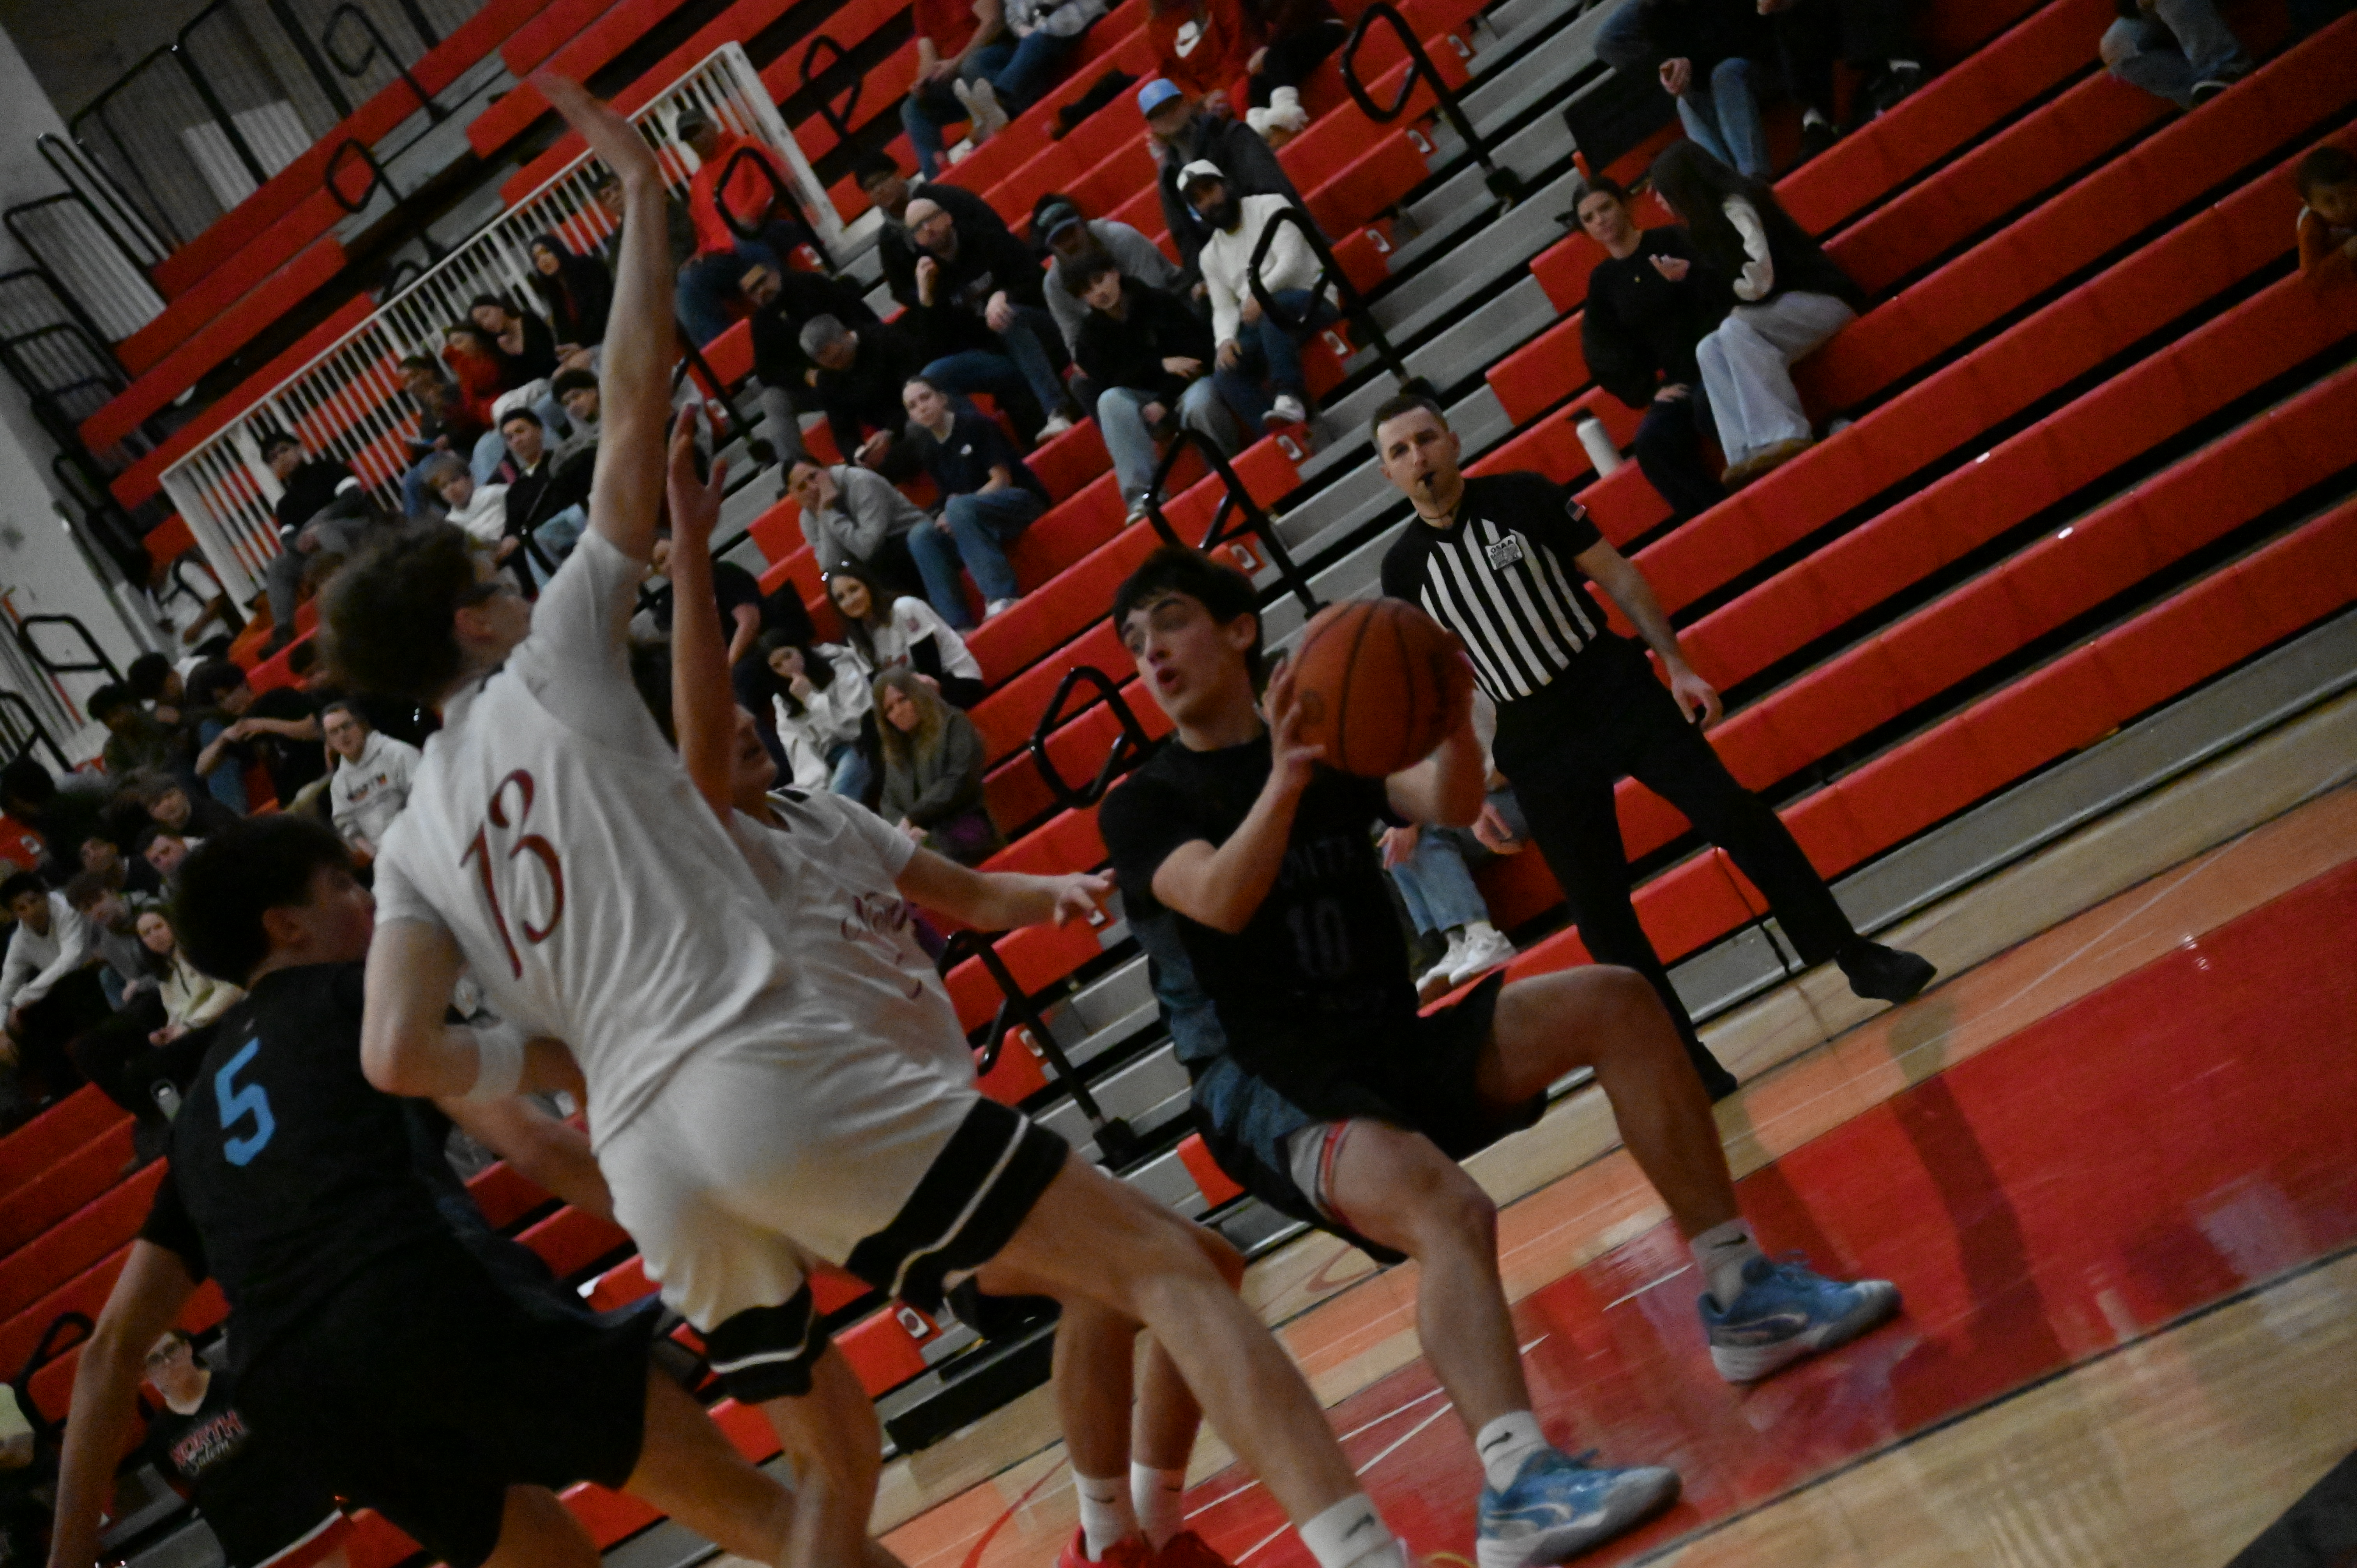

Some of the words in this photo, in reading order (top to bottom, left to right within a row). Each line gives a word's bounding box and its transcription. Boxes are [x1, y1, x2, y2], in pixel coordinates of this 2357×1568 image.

[460, 769, 564, 979] 13
[1285, 895, 1352, 979] 10
[214, 1035, 277, 1167] 5
[168, 1408, 246, 1470] NORTH
